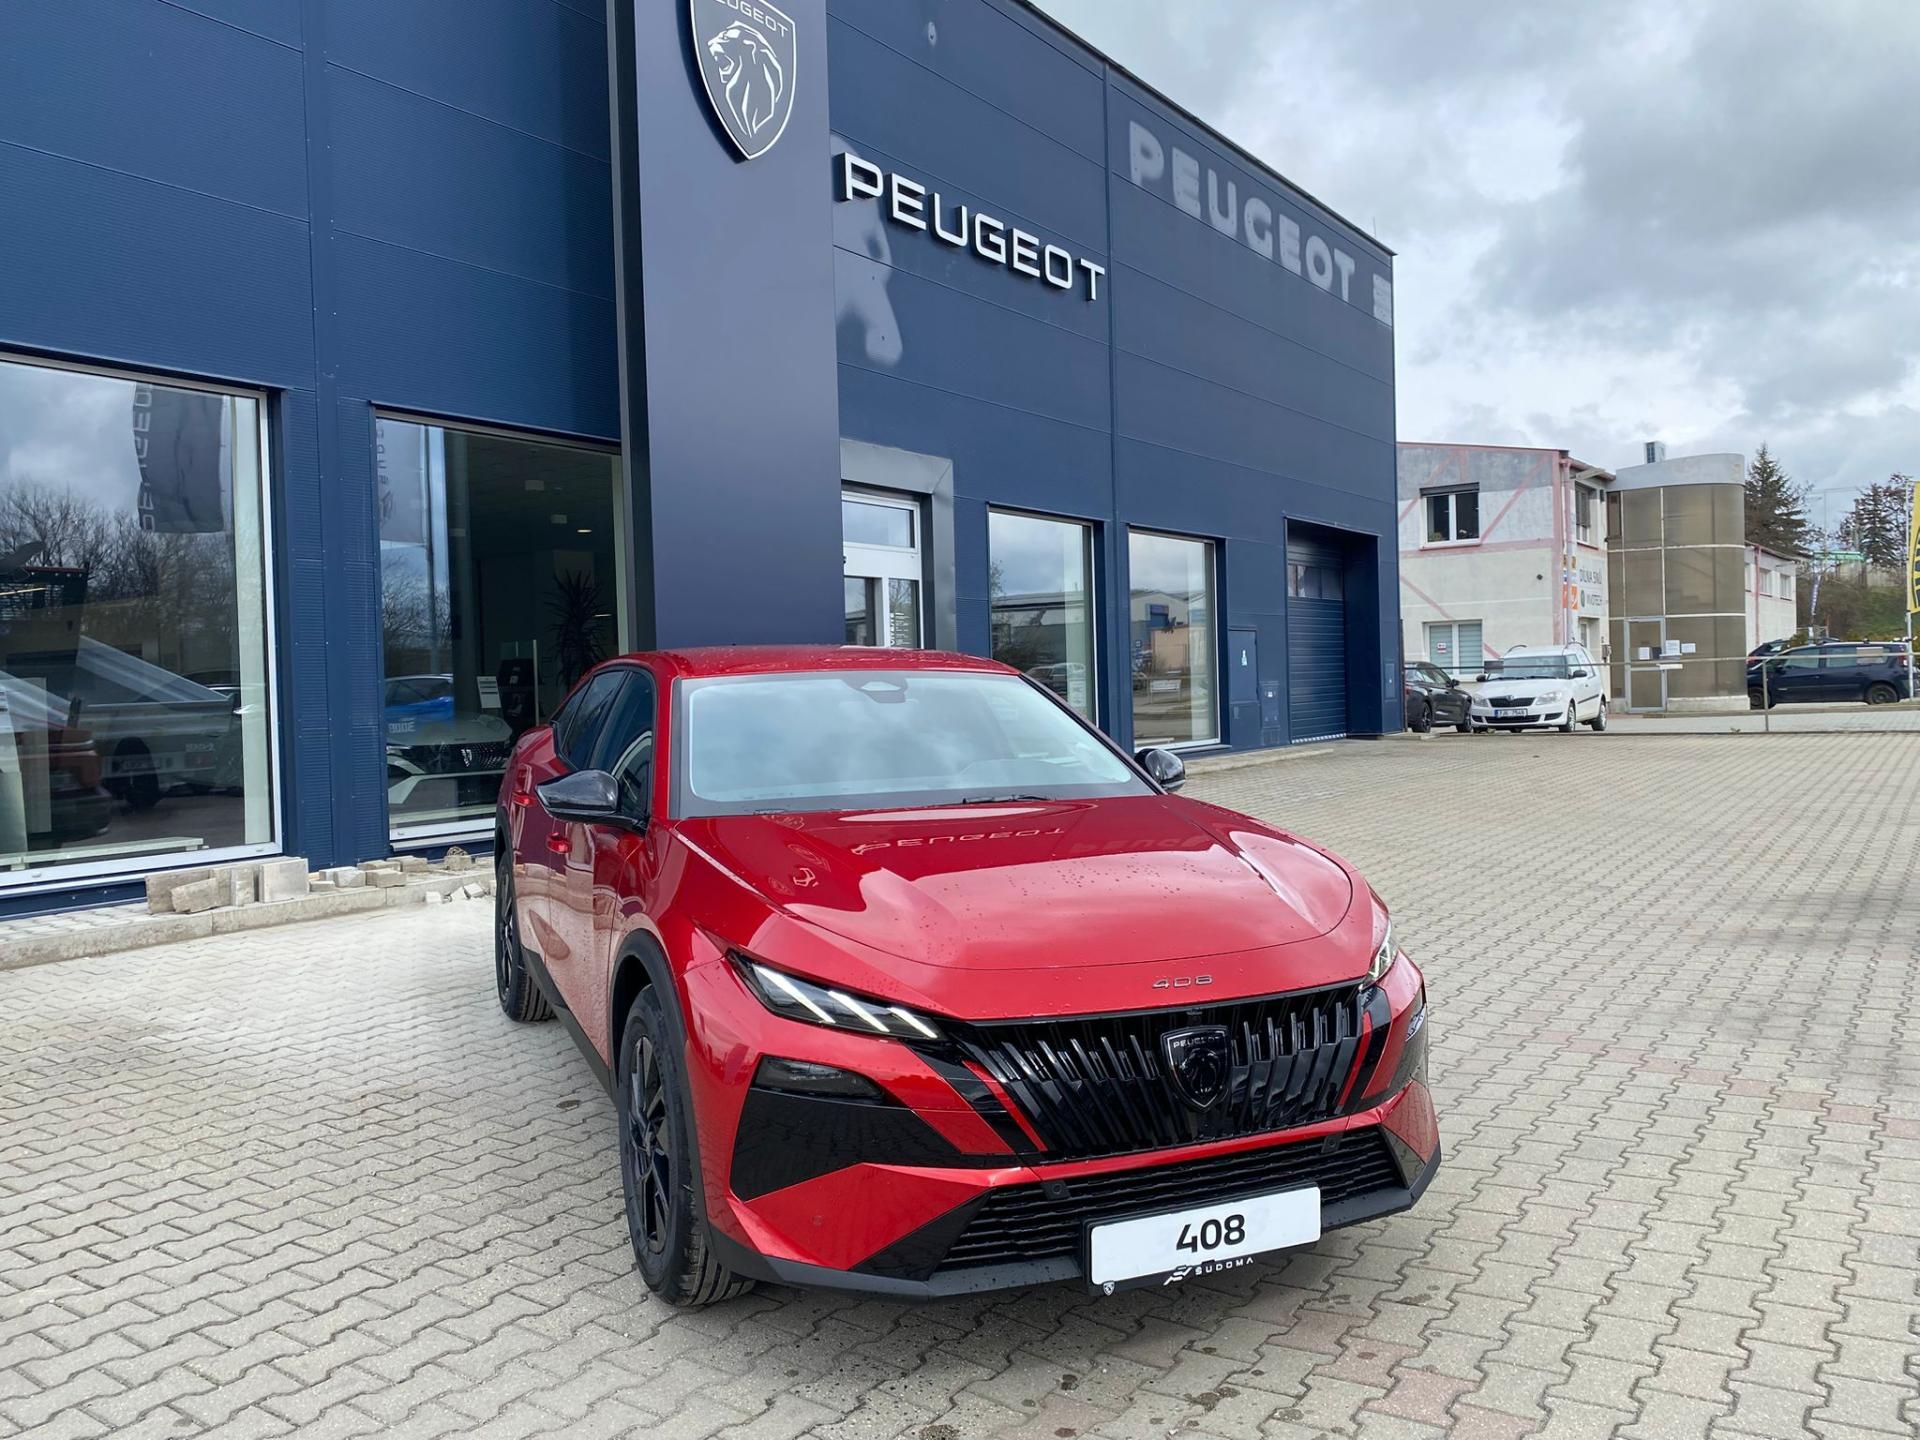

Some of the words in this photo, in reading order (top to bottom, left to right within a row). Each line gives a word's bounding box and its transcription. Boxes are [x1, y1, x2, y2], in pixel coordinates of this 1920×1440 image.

[715, 0, 788, 38] UGEOT
[842, 152, 1105, 300] PEUGEOT
[1129, 120, 1355, 303] PEUGEOT
[1152, 975, 1213, 989] 408
[1176, 1214, 1246, 1253] 408
[1195, 1256, 1254, 1276] SUDOMA
